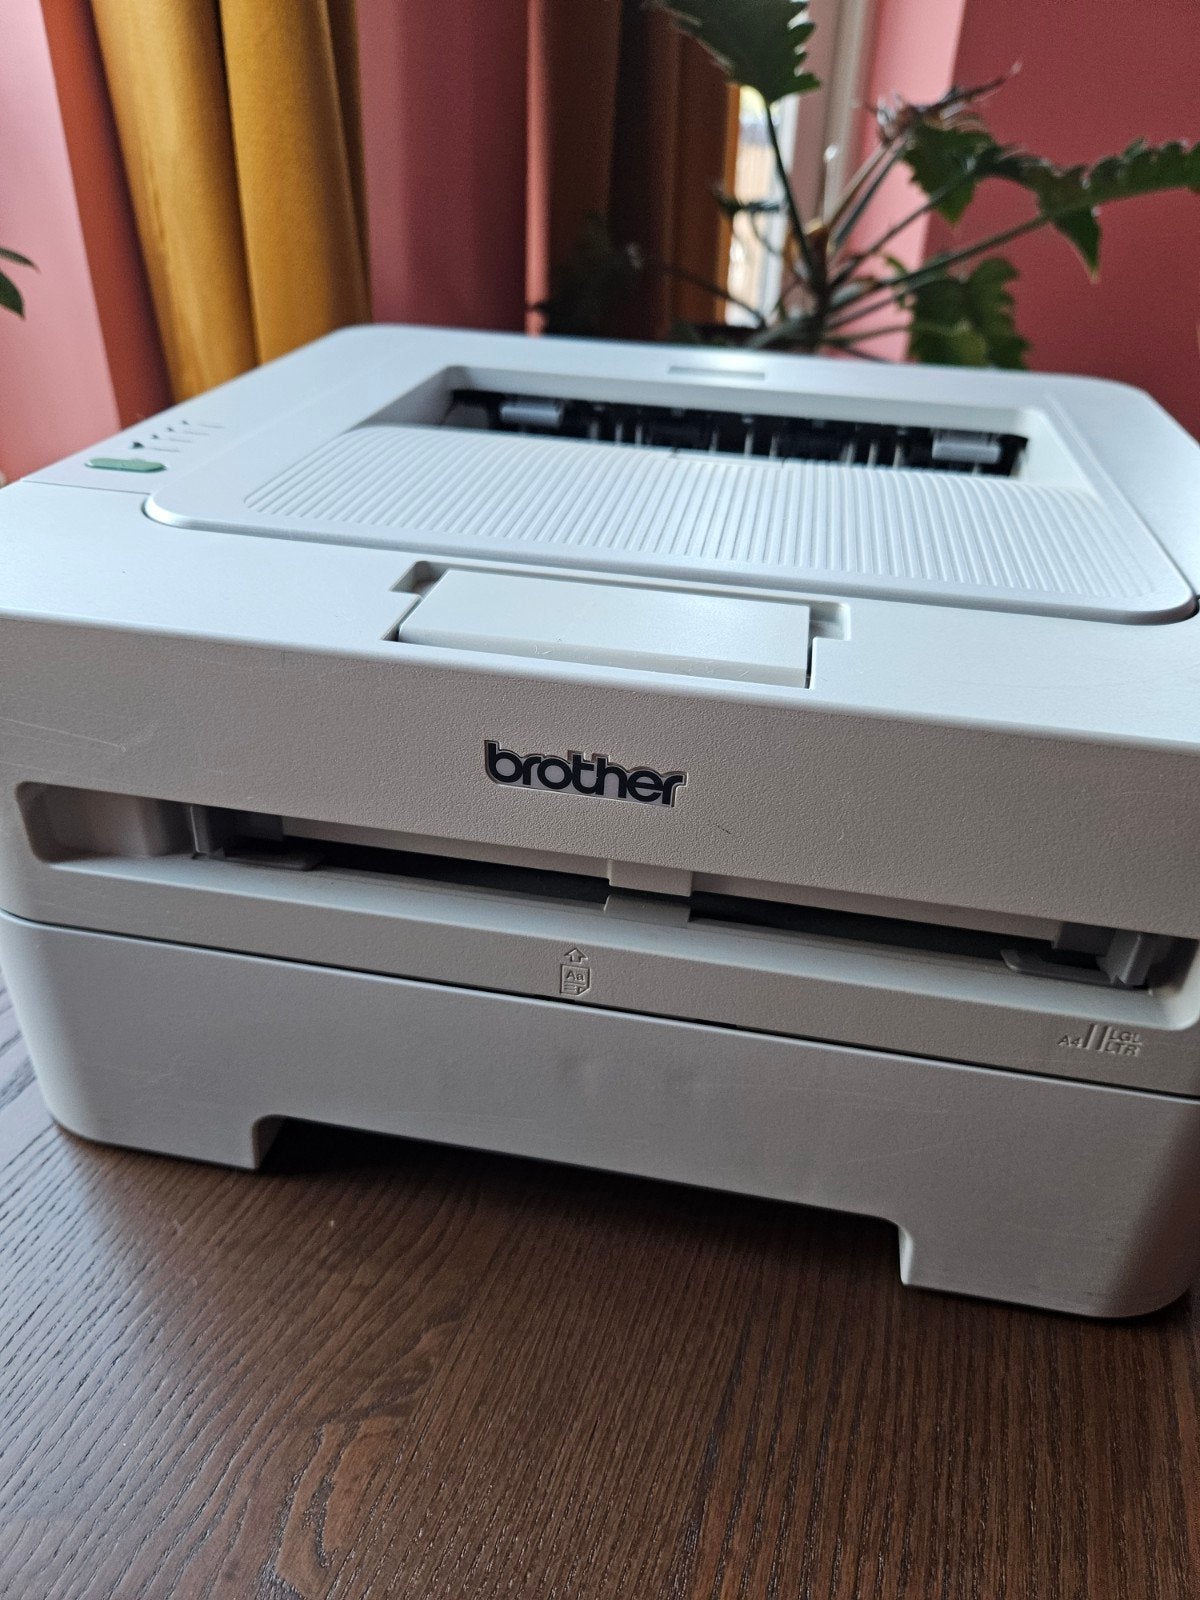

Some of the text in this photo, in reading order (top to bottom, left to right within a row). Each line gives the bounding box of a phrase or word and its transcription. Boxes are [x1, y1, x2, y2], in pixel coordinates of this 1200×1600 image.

[486, 741, 685, 805] brother
[566, 970, 586, 982] Aa
[1058, 1035, 1082, 1048] A4
[1109, 1030, 1141, 1044] LGL
[1106, 1041, 1141, 1057] LTR
